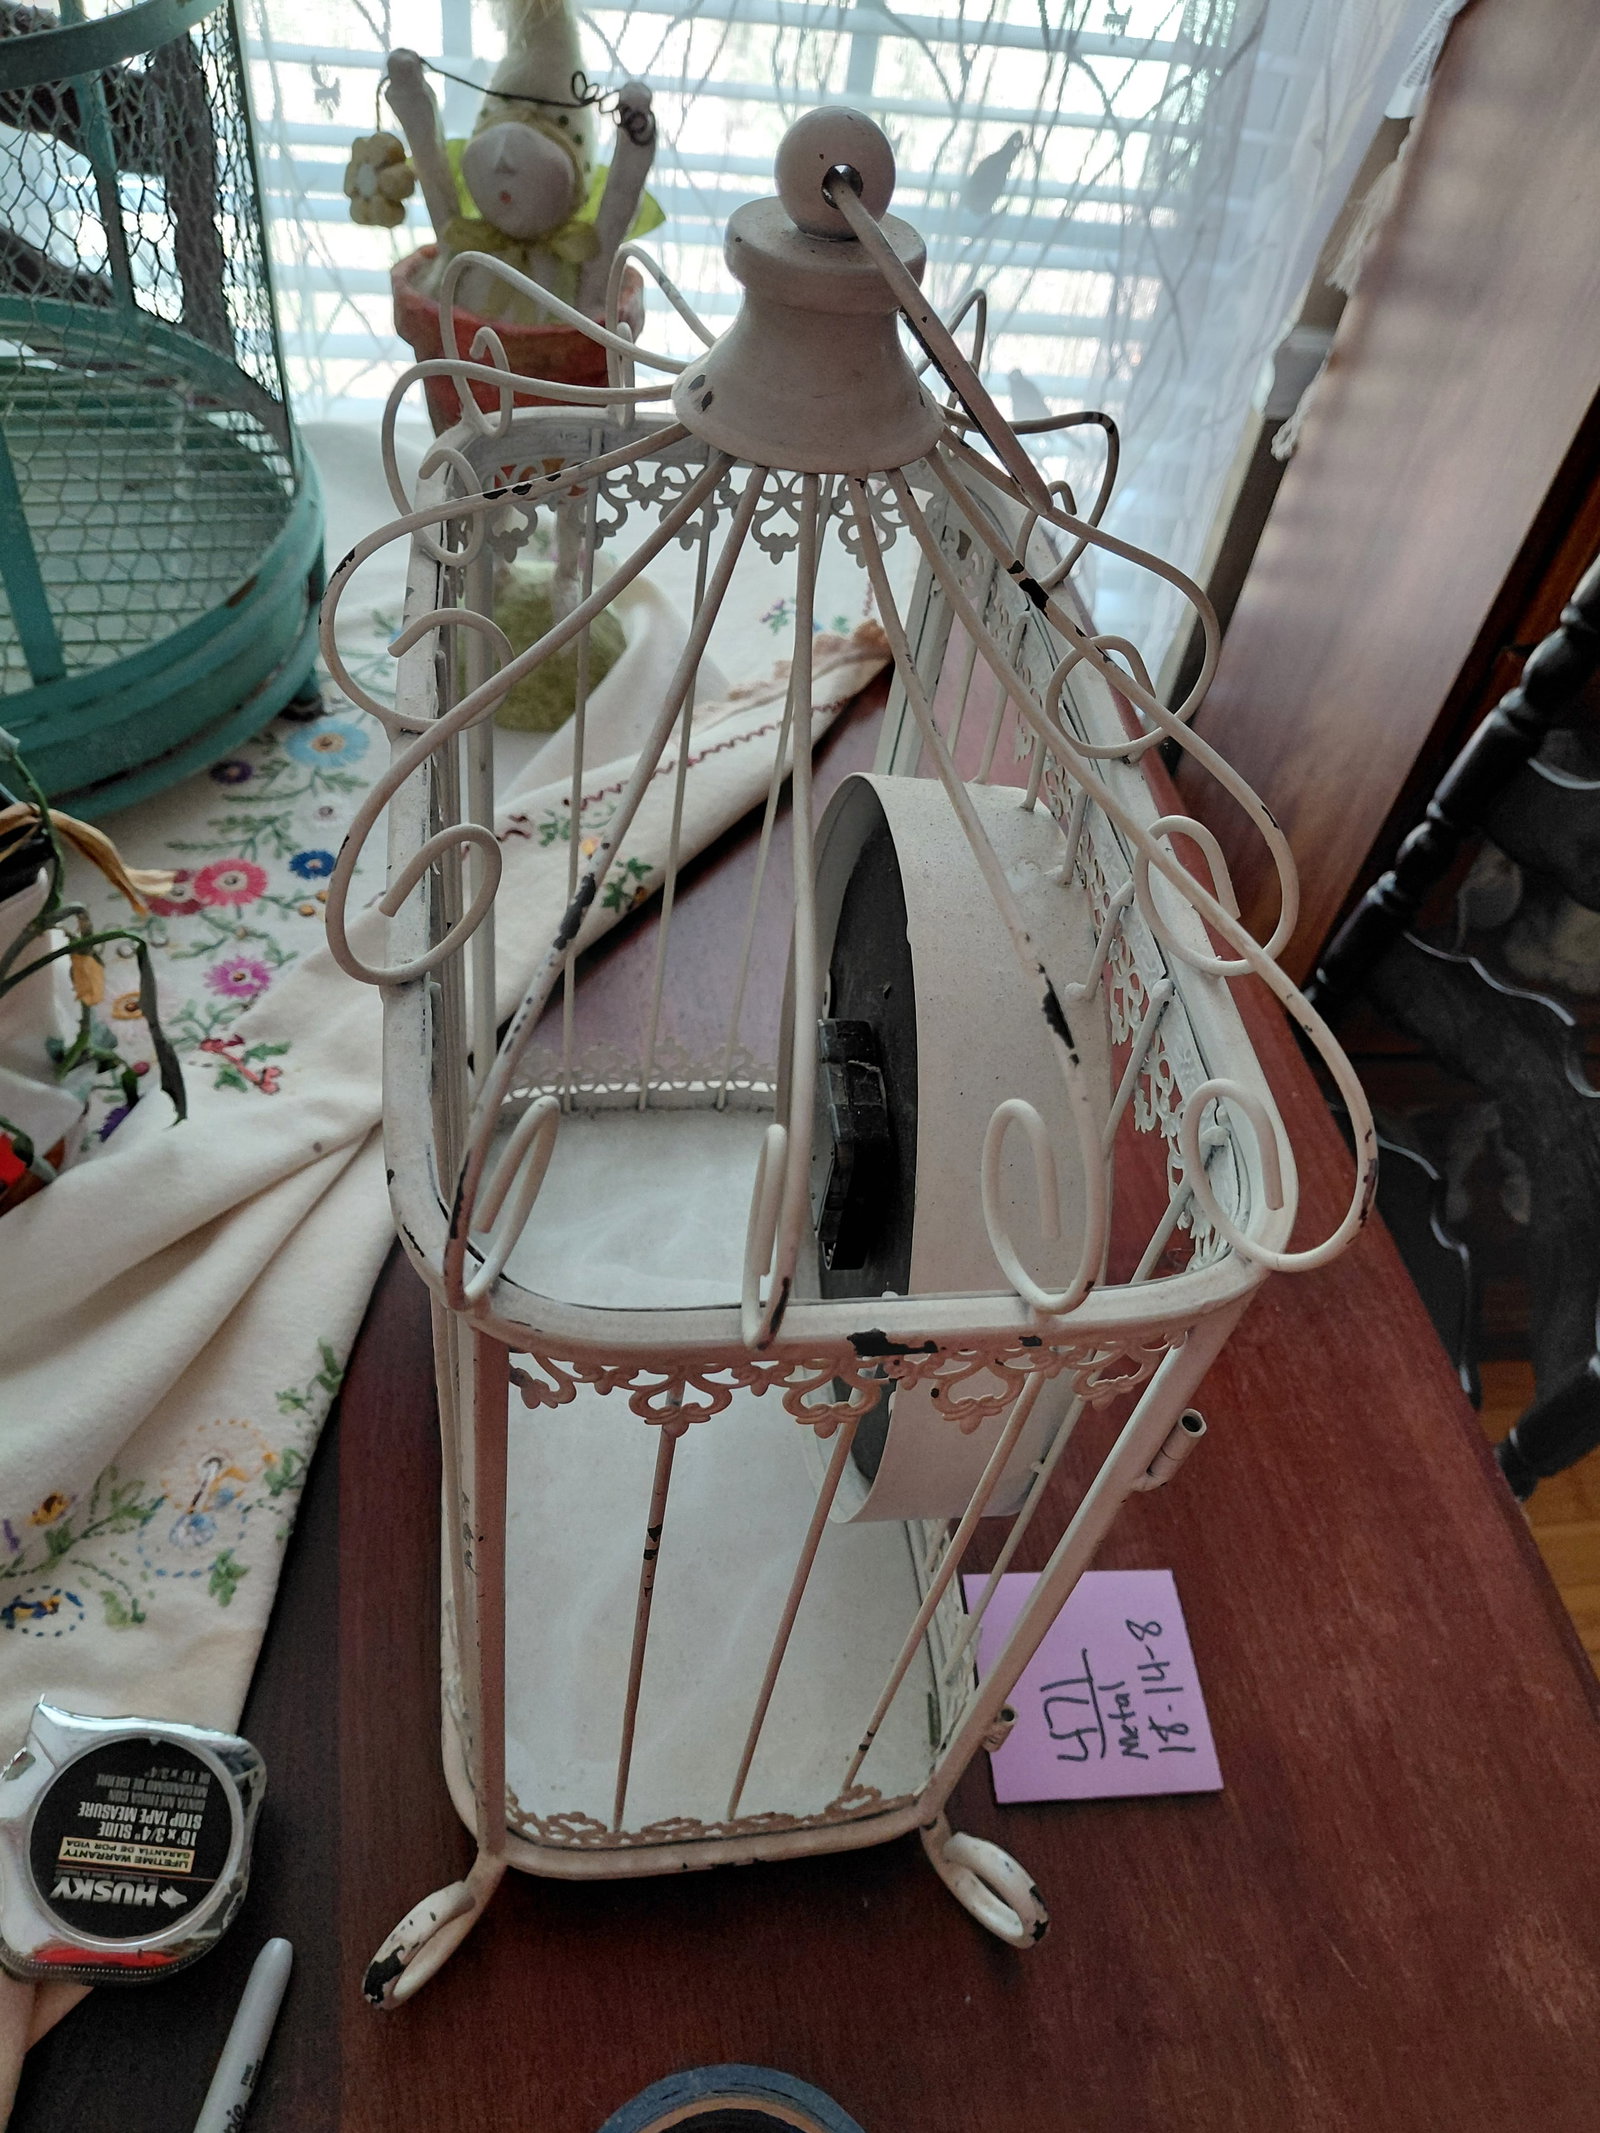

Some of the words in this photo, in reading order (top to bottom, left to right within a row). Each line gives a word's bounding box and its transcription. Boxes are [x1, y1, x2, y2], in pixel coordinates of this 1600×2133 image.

[1040, 1677, 1098, 1762] 471
[1098, 1681, 1148, 1759] Metal
[78, 1801, 138, 1821] MEASURE
[140, 1808, 168, 1825] TAPE
[170, 1812, 203, 1829] STOP
[97, 1821, 133, 1837] SLIDE
[134, 1826, 166, 1843] 3/4"
[66, 1840, 90, 1848] VIDA
[177, 1831, 197, 1846] 16'
[94, 1843, 117, 1851] POR
[120, 1846, 134, 1854] DE
[63, 1849, 131, 1862] WARRANTY
[134, 1855, 189, 1869] LIFETIME
[49, 1876, 158, 1907] HUSKY
